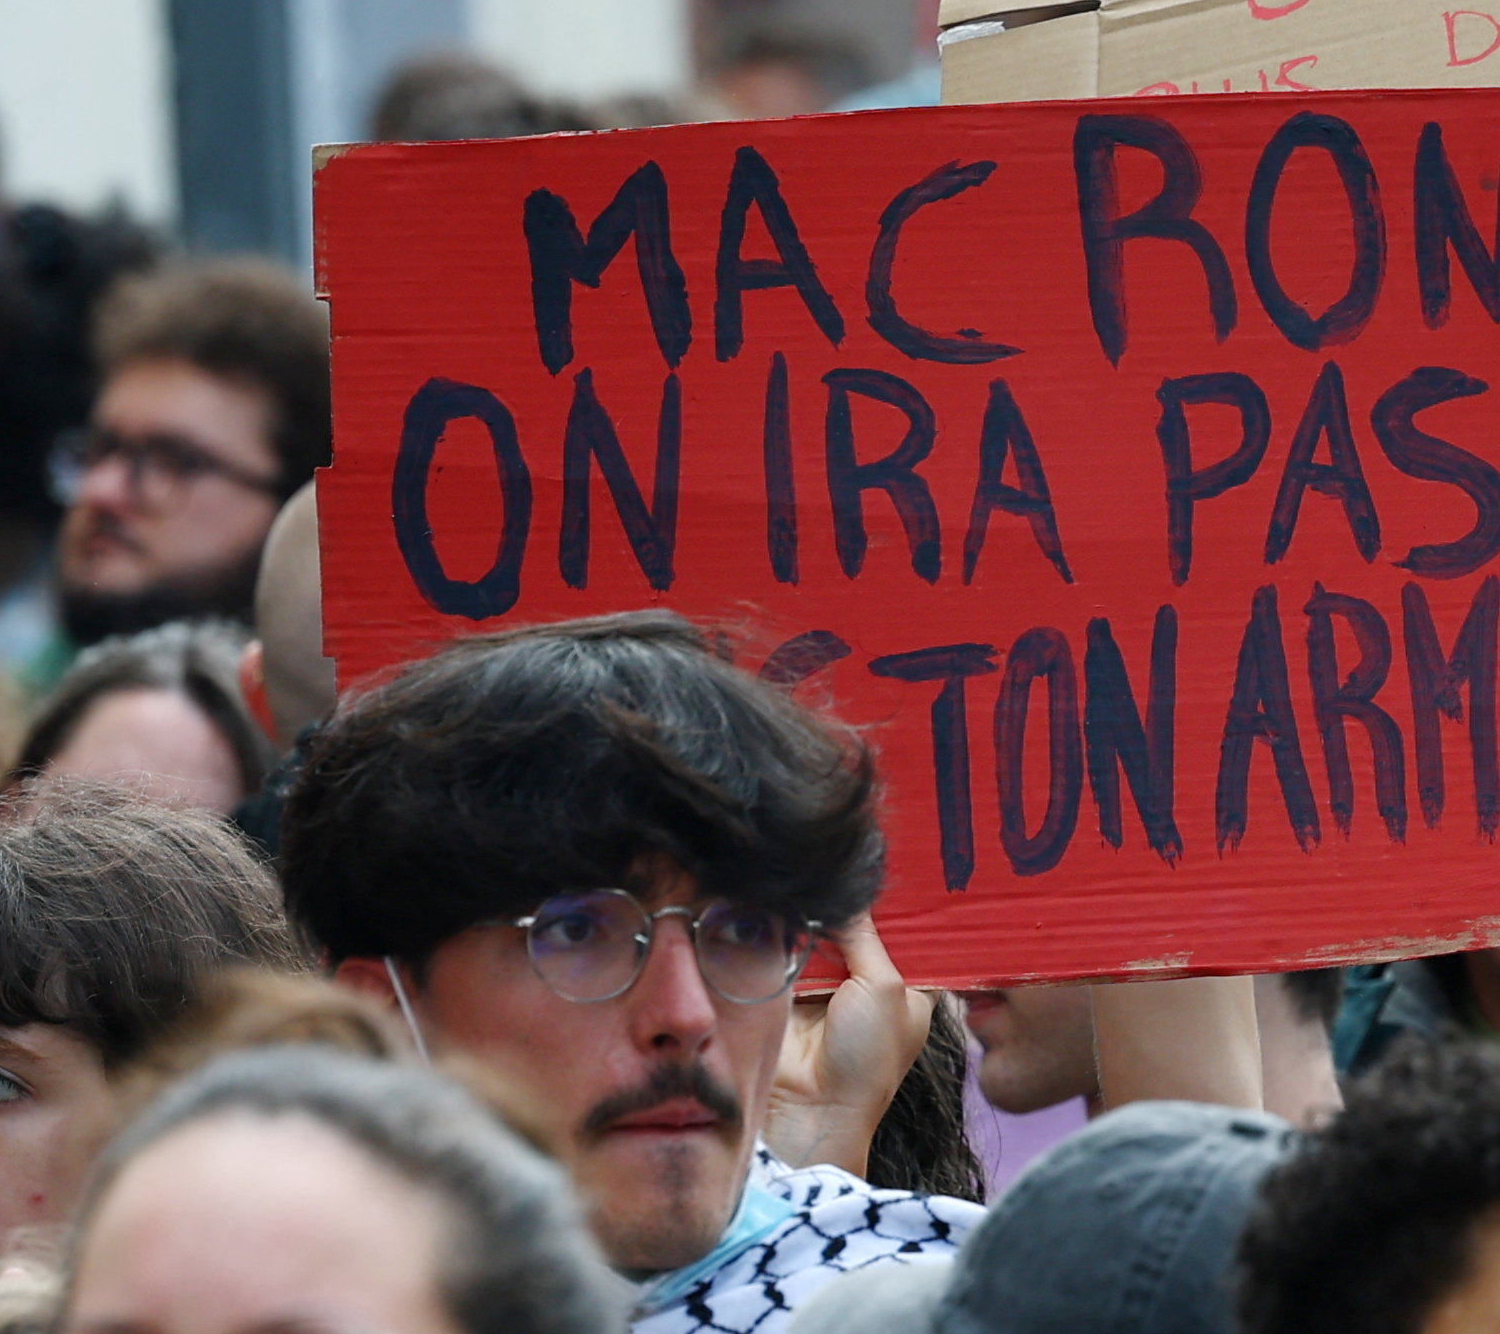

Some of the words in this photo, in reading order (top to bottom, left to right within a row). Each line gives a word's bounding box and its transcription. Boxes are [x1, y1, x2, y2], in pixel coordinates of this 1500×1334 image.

[391, 366, 681, 622] ON
[765, 352, 1074, 584] IRA
[867, 603, 1184, 893] TON
